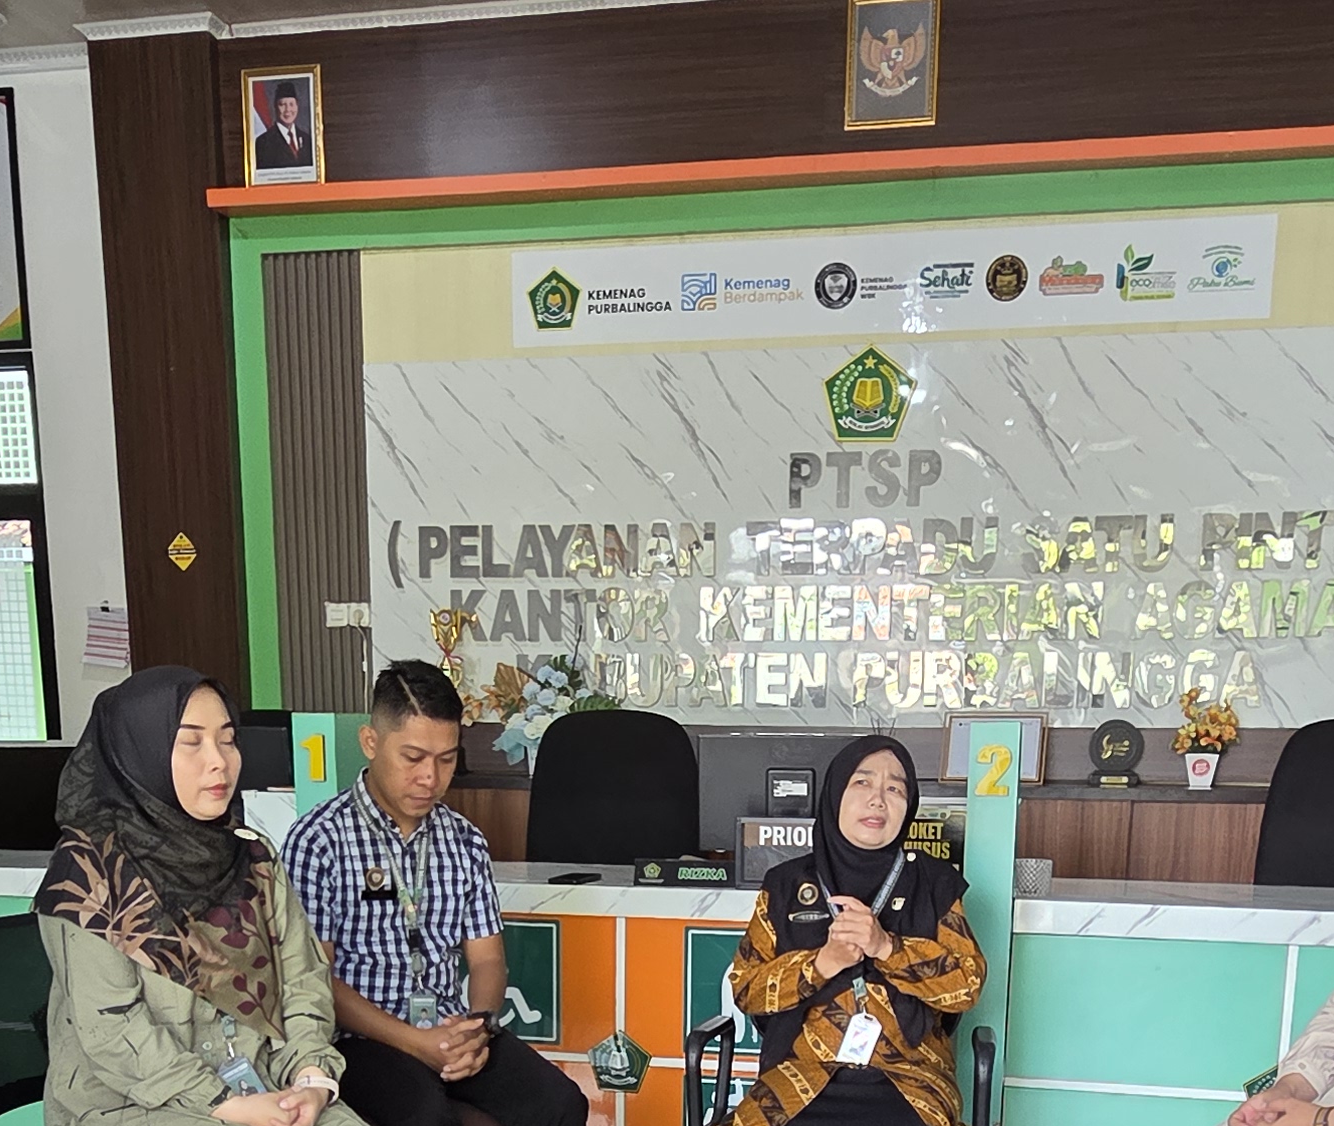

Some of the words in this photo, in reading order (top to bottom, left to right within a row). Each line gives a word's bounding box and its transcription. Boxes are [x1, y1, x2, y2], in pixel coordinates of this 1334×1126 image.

[587, 288, 646, 301] KEMENAG
[723, 277, 791, 291] Kemenag
[723, 289, 805, 304] Berdampak
[587, 301, 672, 315] PURBALINGGA
[788, 449, 942, 509] PTSP
[745, 517, 999, 577] TERPADU
[1019, 512, 1175, 574] SATU
[449, 586, 670, 644] KANTOR
[697, 580, 1105, 644] KEMENTERIAN
[517, 651, 828, 709] BUPATEN
[851, 648, 1262, 710] PURBALINGGA
[300, 734, 326, 783] 1
[976, 744, 1013, 797] 2
[907, 822, 944, 840] OKET
[677, 866, 728, 881] RIZKA
